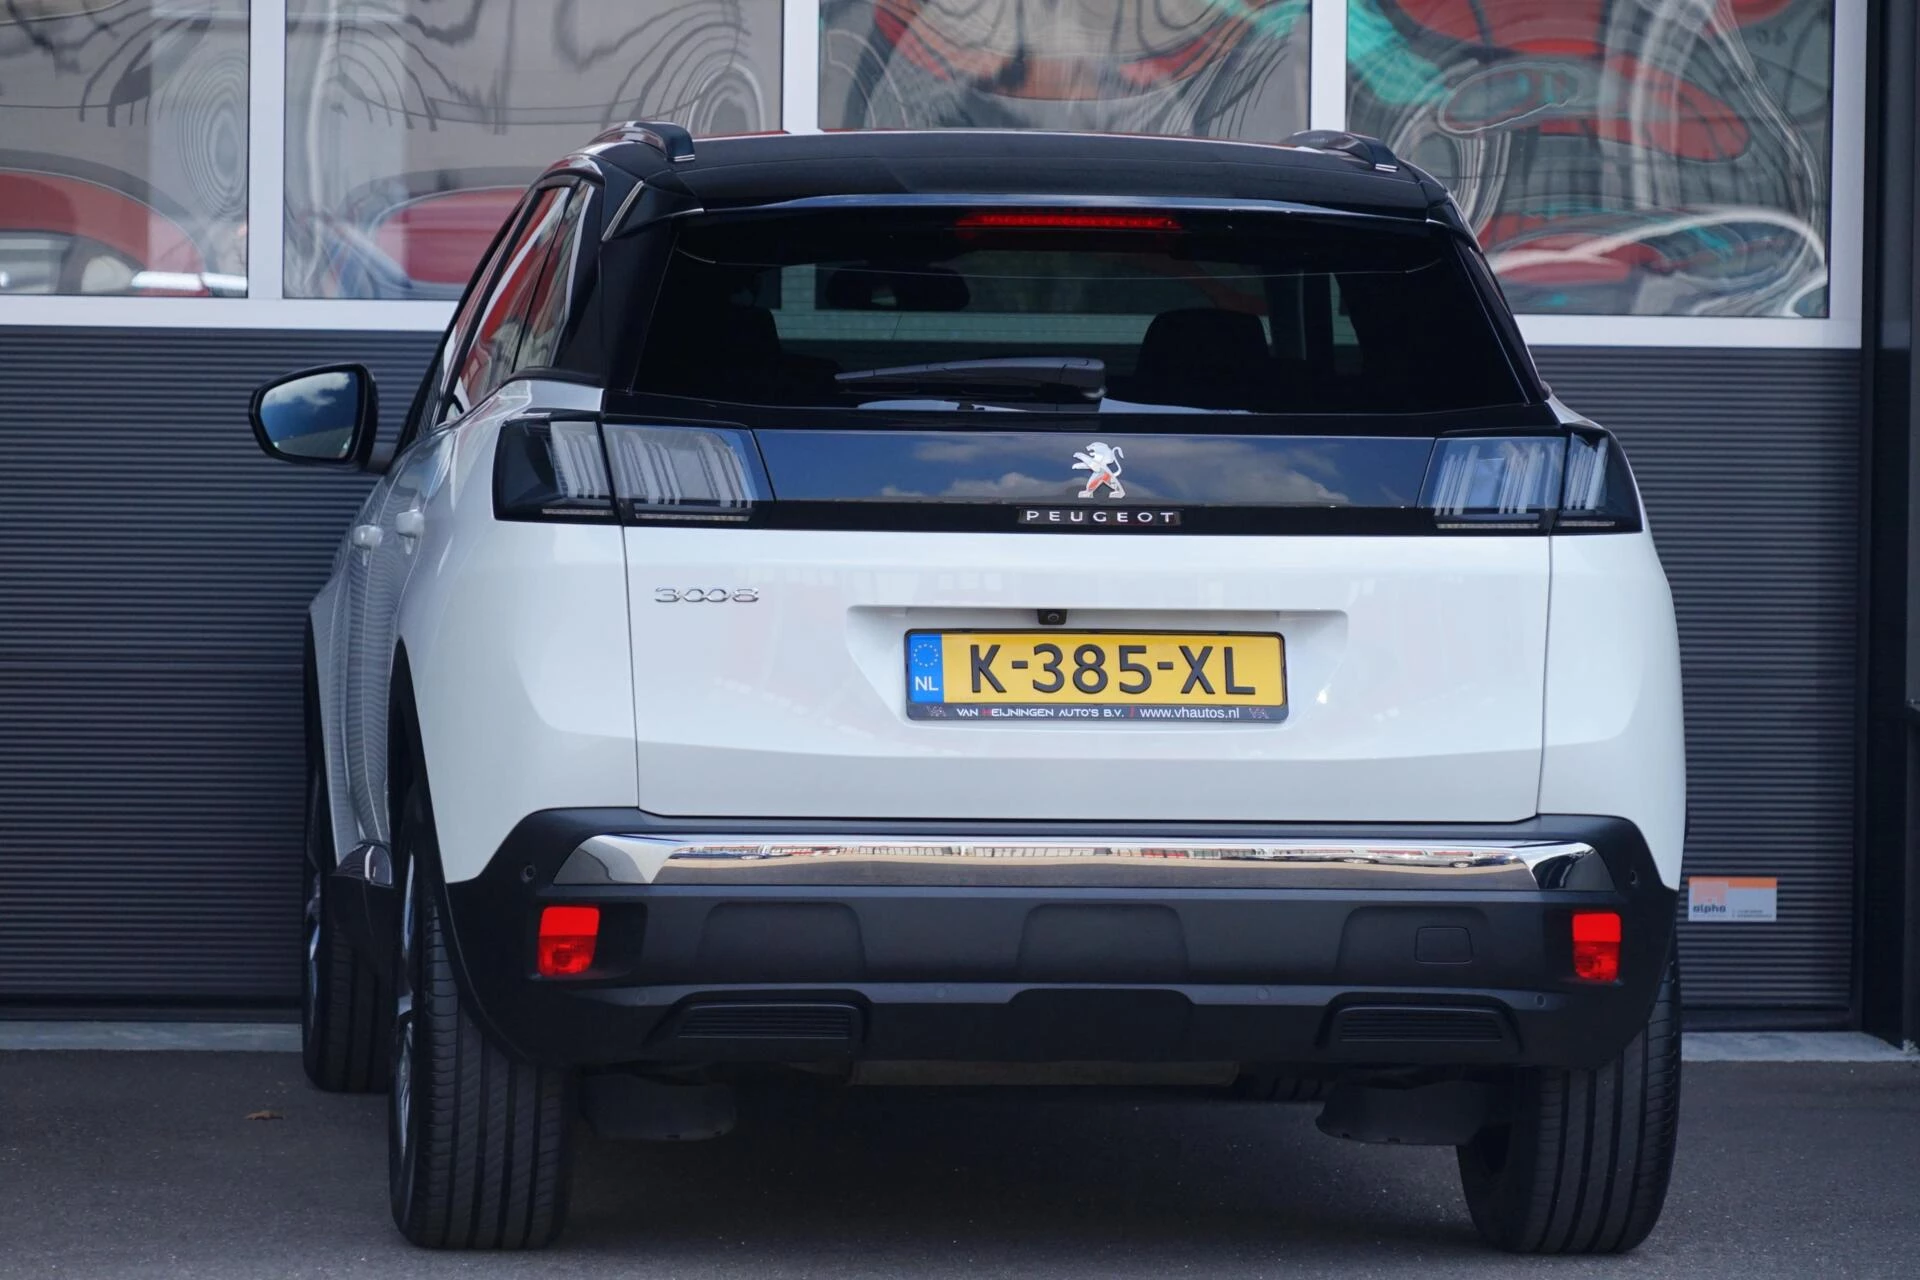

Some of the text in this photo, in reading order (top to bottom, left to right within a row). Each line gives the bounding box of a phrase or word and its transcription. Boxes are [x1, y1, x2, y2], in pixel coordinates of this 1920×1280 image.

[1026, 510, 1174, 523] PEUGEOT
[655, 588, 759, 603] 3008
[970, 643, 1256, 695] K-385-XL
[915, 676, 939, 691] NL
[956, 708, 979, 717] VAN
[1058, 708, 1099, 718] AUTO'S
[1103, 708, 1125, 718] B.V.
[1140, 707, 1240, 719] www.vhautos.nl
